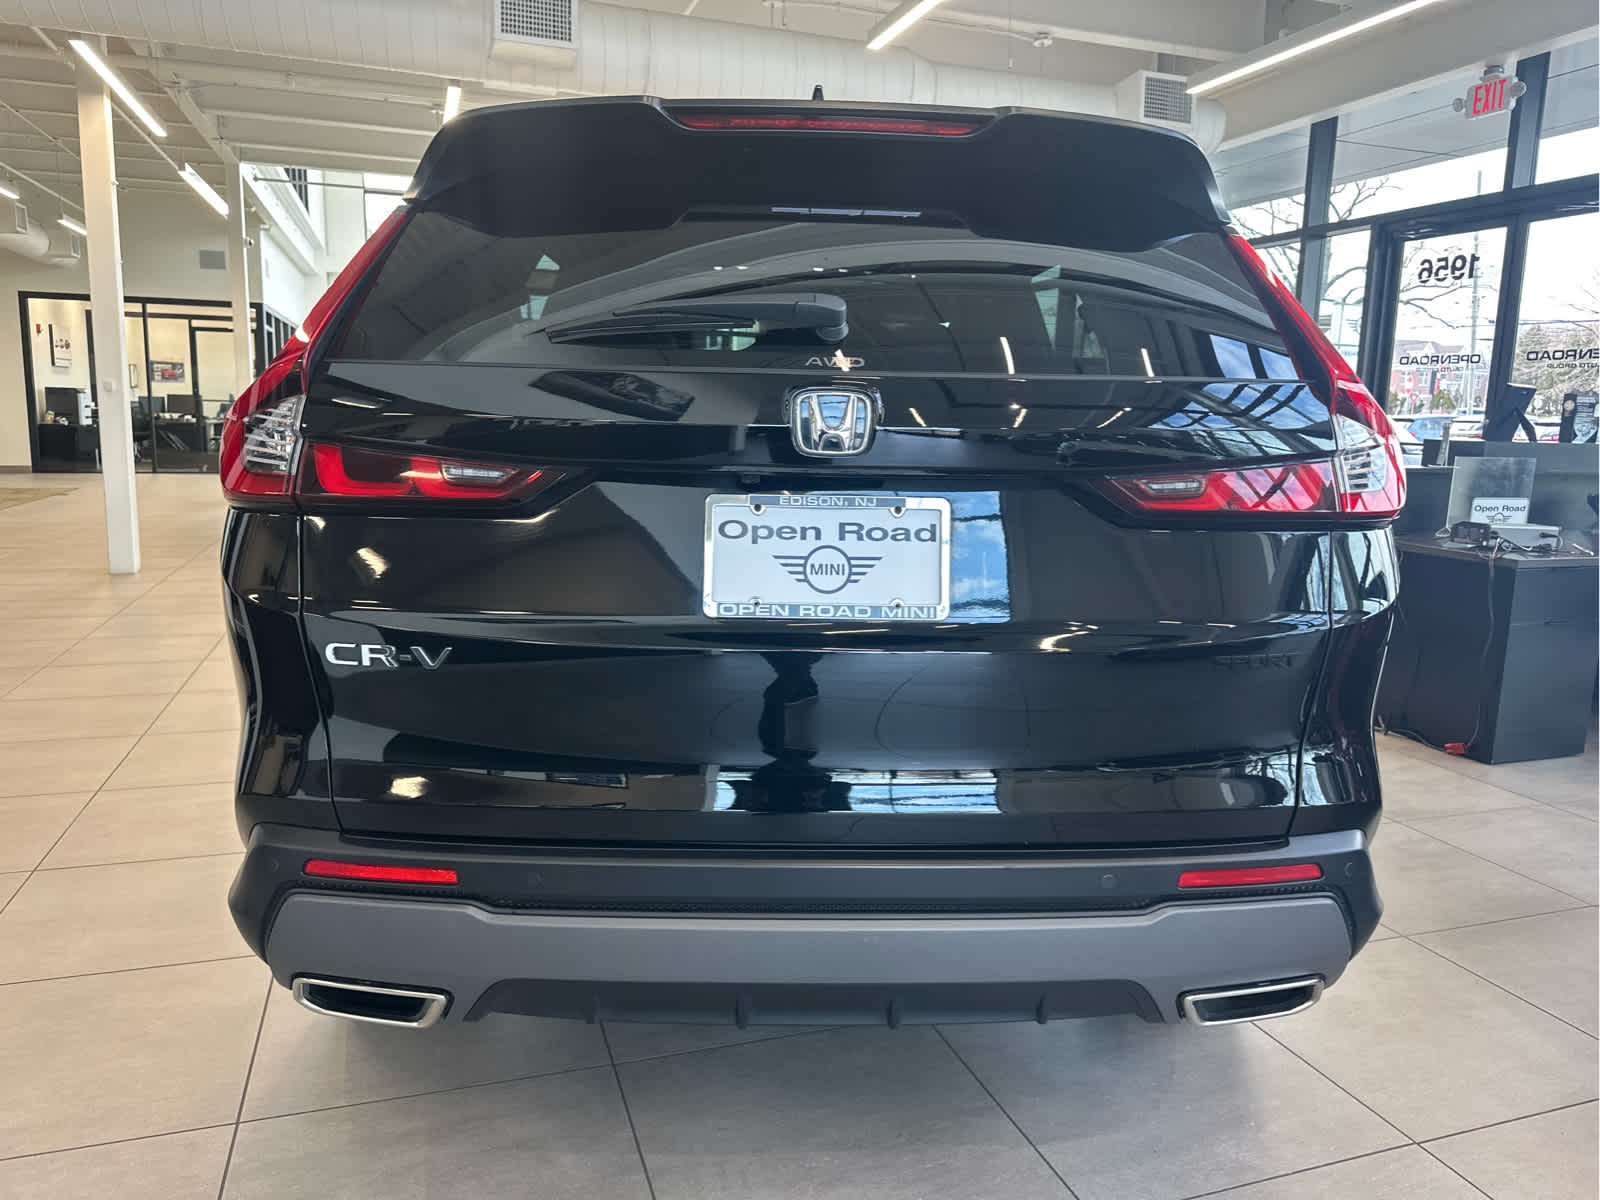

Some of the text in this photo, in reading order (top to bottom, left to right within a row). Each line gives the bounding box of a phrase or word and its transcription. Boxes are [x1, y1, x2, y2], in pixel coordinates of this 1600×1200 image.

[1472, 79, 1507, 115] EXIT
[805, 357, 864, 367] AWD
[779, 496, 877, 507] EDISON, NJ
[1474, 504, 1499, 513] Open
[718, 519, 937, 545] Open Road
[809, 563, 846, 576] MINI
[719, 603, 935, 618] OPEN ROAD MINI
[325, 643, 452, 670] CR-V
